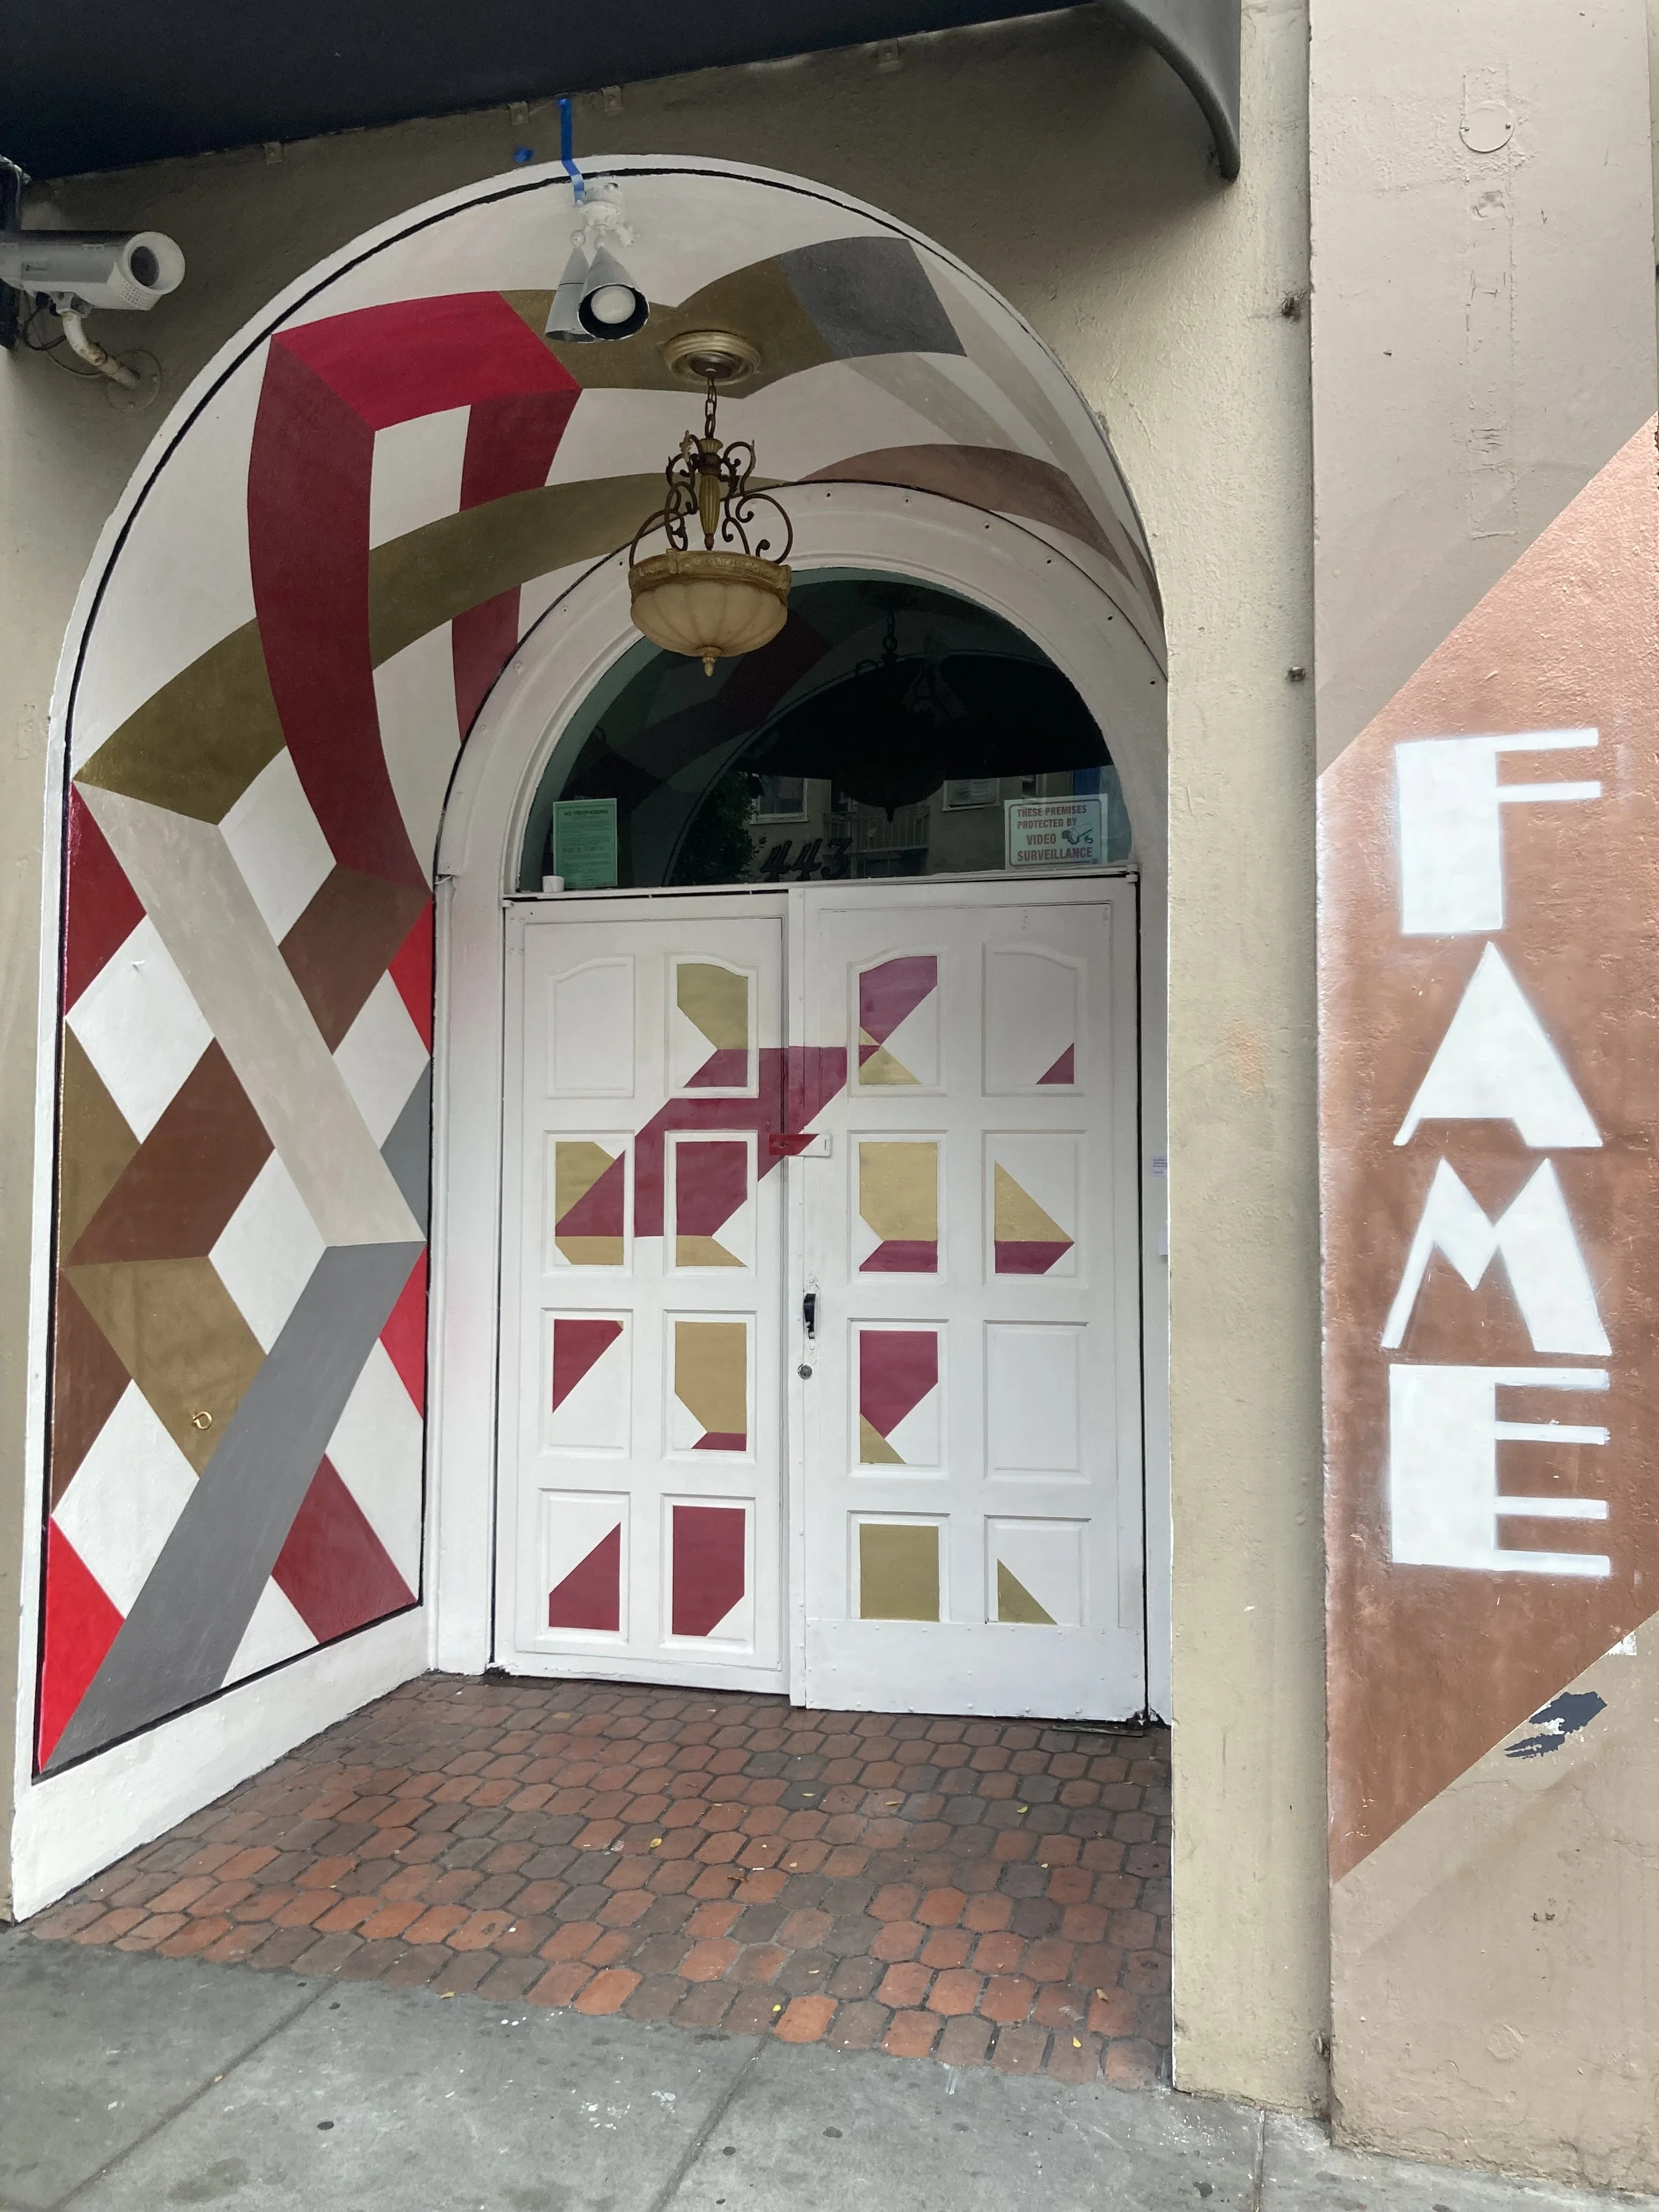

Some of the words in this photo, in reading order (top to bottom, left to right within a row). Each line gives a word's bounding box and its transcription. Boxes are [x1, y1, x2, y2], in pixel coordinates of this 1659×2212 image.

[1017, 808, 1043, 818] THESE
[1045, 805, 1087, 816] PREMISES
[1017, 819, 1064, 830] PROTECTED
[1066, 817, 1078, 826] BY
[1027, 834, 1056, 846] VIDEO
[760, 838, 853, 883] 443
[1017, 847, 1093, 861] SURVEILLANCE
[1380, 727, 1613, 1577] FAME
